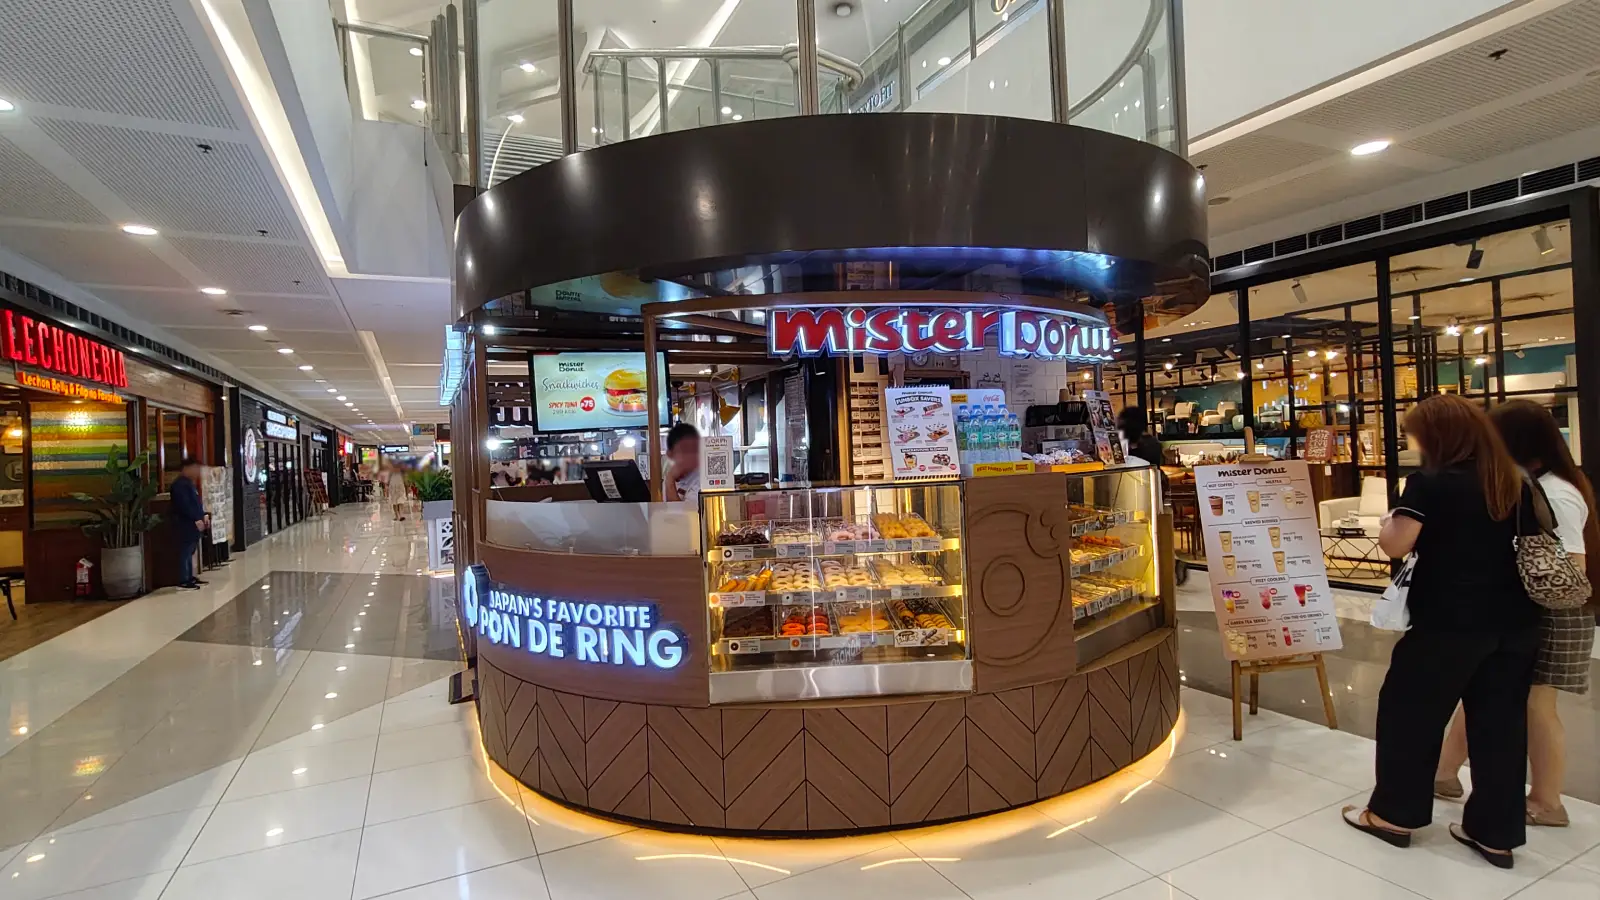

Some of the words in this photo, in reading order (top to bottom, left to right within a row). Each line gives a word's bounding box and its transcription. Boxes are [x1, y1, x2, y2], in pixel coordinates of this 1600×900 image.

[3, 309, 128, 389] LECHONERIA
[22, 371, 50, 390] Lechon
[489, 590, 543, 619] JAPAN'S
[547, 599, 651, 629] FAVORITE
[479, 605, 522, 649] PON
[527, 618, 565, 659] DE
[574, 624, 684, 669] RING
